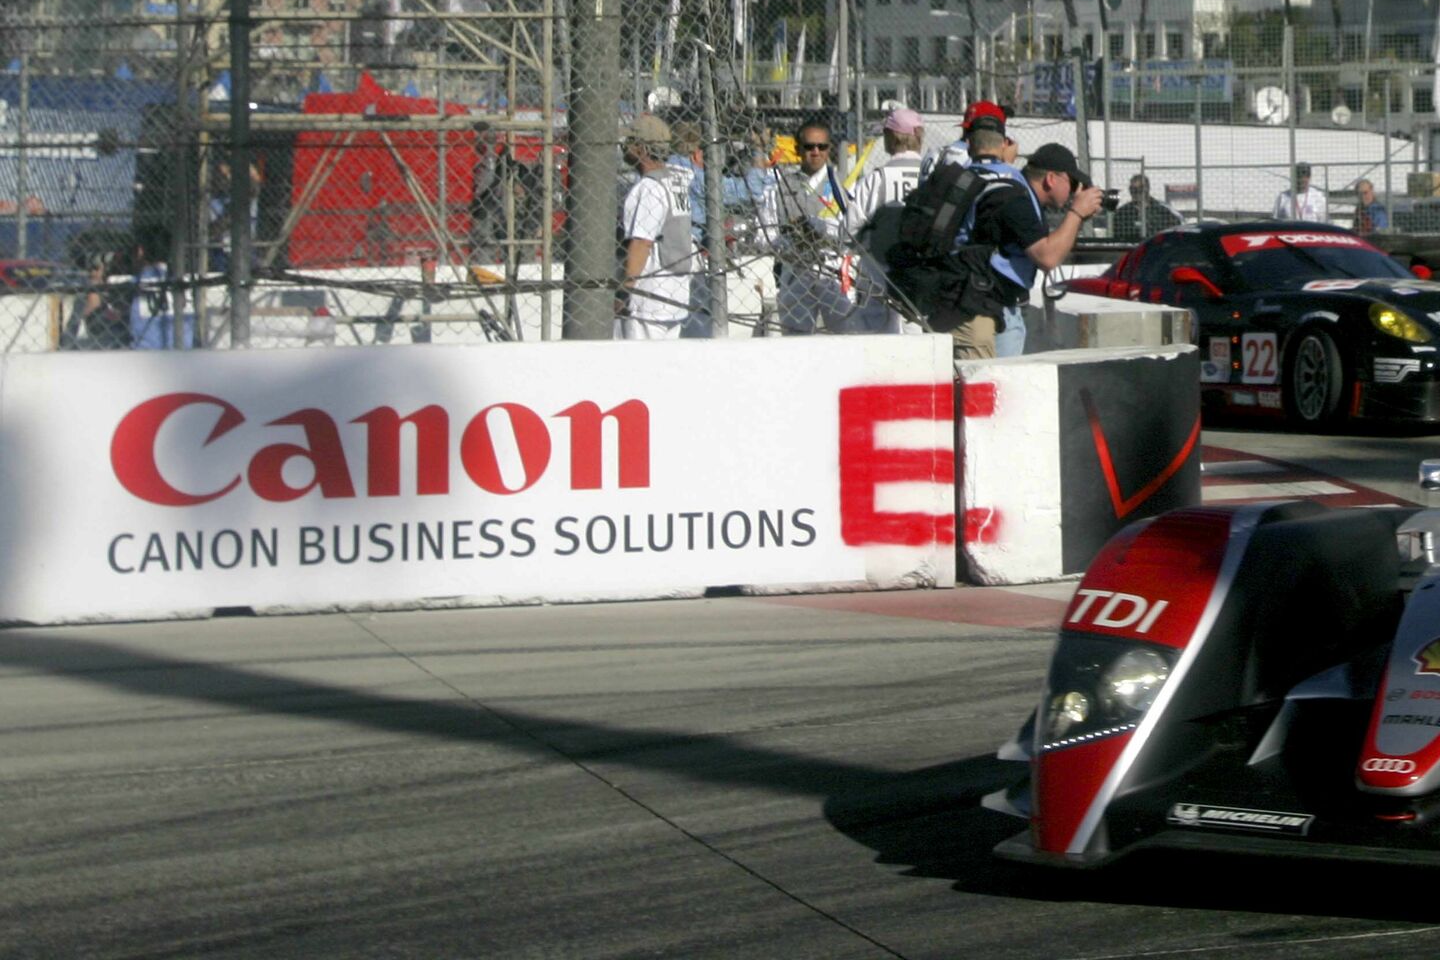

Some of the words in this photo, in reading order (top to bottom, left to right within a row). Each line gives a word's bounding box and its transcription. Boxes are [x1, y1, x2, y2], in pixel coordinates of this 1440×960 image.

[1246, 339, 1275, 377] 22
[110, 392, 650, 507] Canon
[107, 528, 278, 574] CANON
[300, 518, 536, 565] BUSINESS
[554, 508, 817, 556] SOLUTIONS
[1069, 589, 1169, 633] TDI
[1201, 809, 1307, 827] MICHELIN
